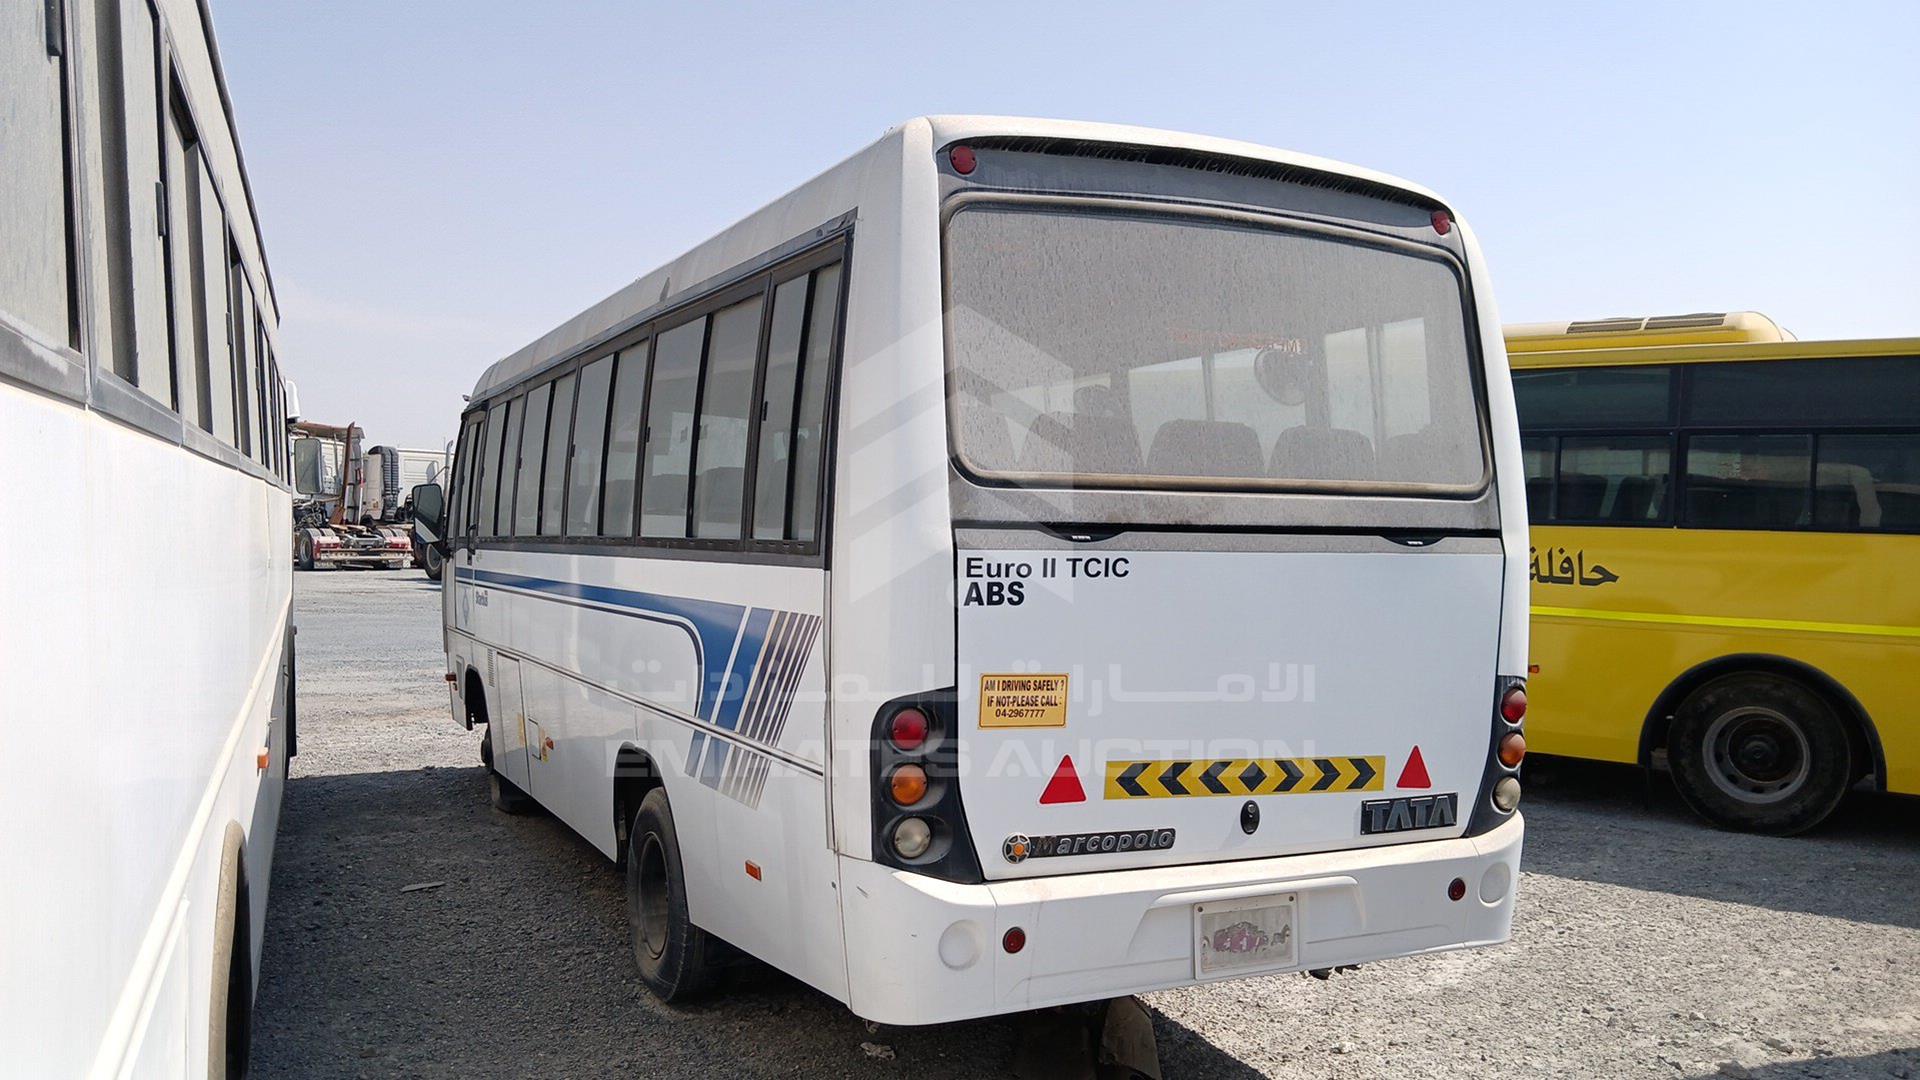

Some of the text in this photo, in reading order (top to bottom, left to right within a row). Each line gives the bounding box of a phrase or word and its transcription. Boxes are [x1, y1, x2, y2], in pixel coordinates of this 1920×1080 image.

[966, 557, 1130, 579] Euro II TCIC
[964, 581, 1025, 606] ABS
[984, 680, 996, 691] AM
[1001, 680, 1032, 691] DRIVING
[1032, 680, 1059, 691] SAFELY
[987, 696, 994, 707] IF
[995, 708, 1045, 718] 04-2967777
[1366, 795, 1455, 832] TATA
[1035, 830, 1174, 857] Marcopolo
